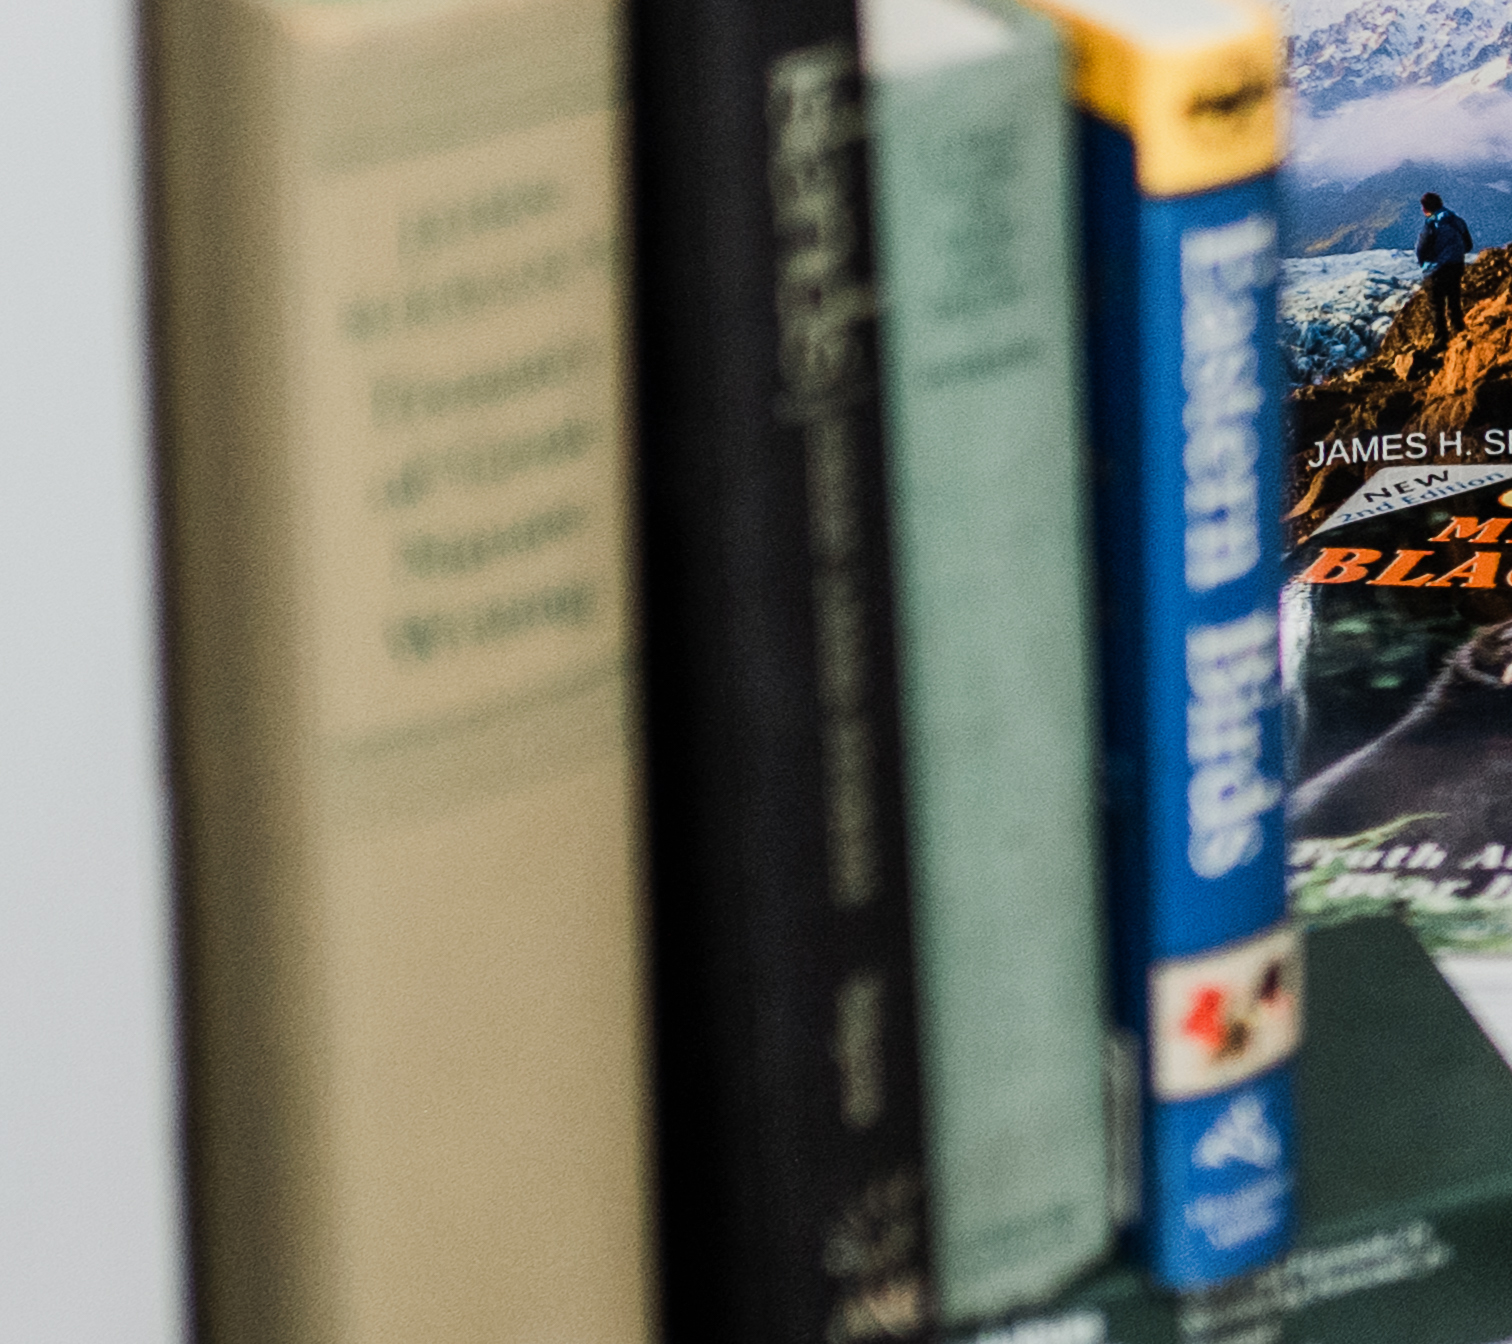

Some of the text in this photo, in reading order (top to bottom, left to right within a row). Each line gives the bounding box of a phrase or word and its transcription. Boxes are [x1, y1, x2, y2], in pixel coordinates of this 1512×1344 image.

[1308, 432, 1428, 468] JAMES
[1439, 430, 1472, 457] H.
[1340, 471, 1505, 522] 2nd Edition
[1362, 470, 1450, 503] NEW
